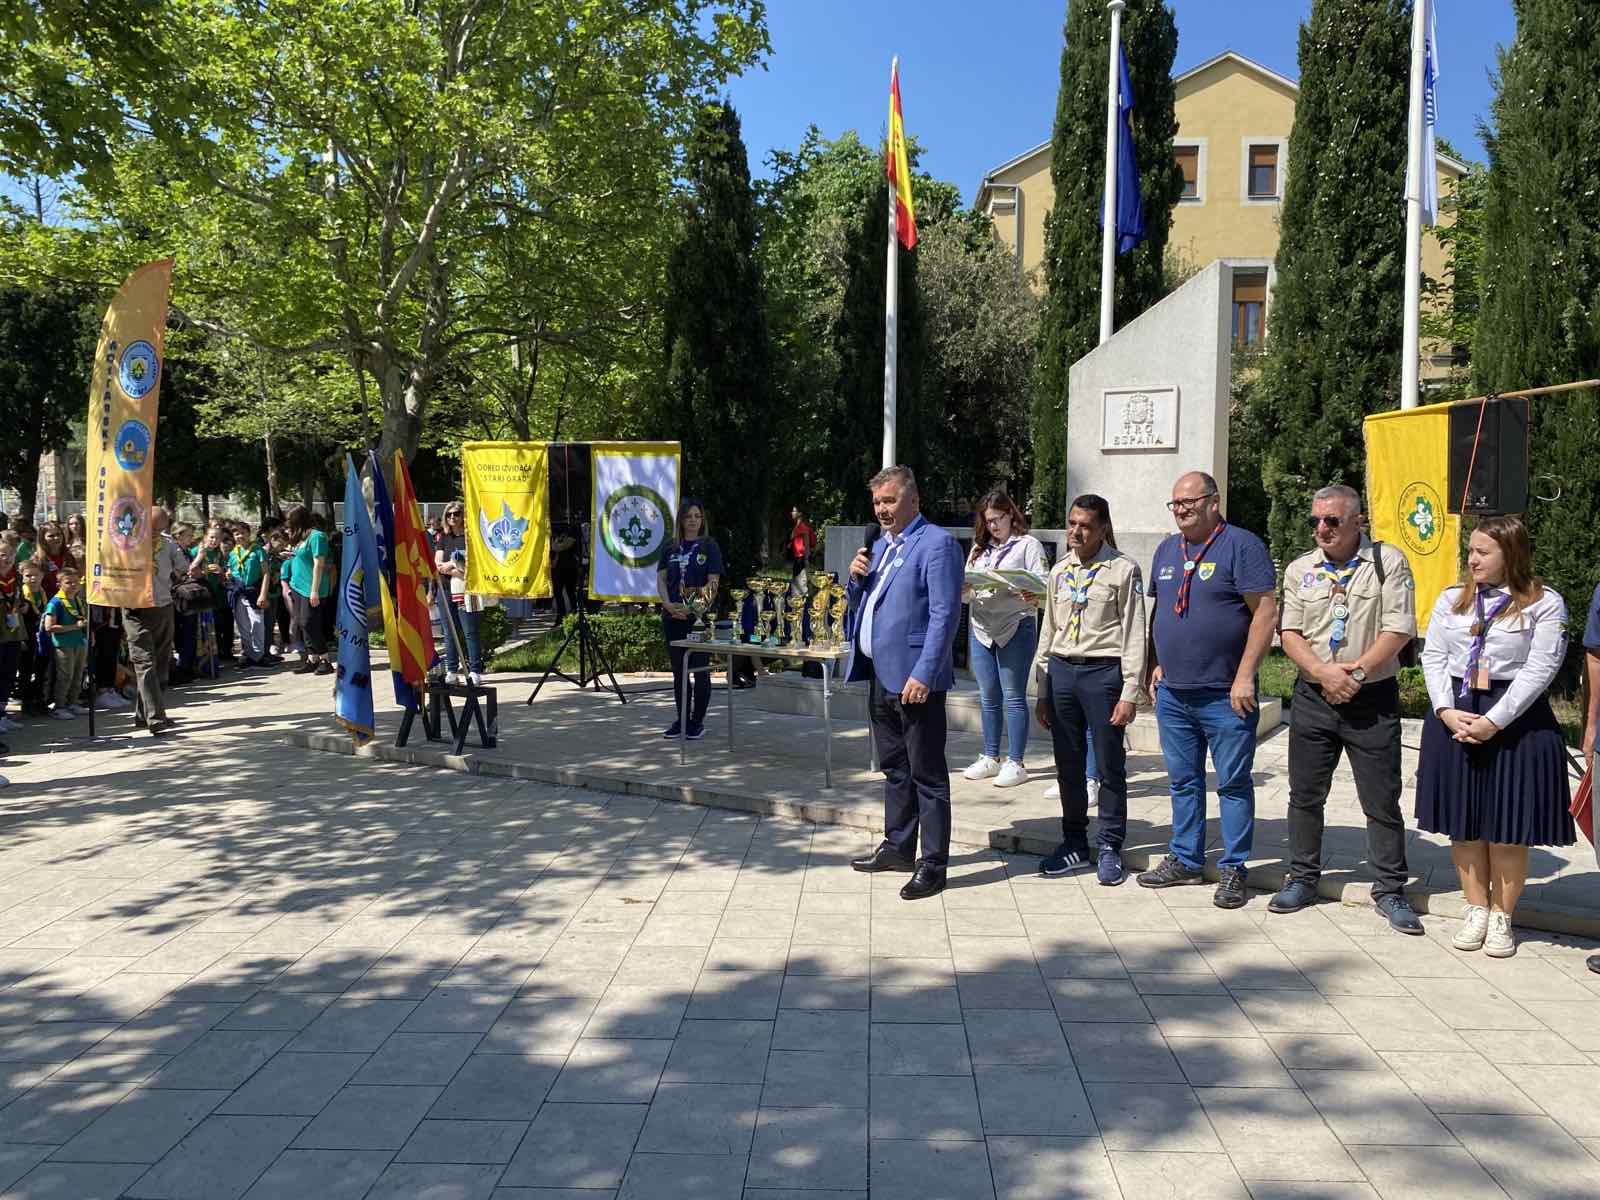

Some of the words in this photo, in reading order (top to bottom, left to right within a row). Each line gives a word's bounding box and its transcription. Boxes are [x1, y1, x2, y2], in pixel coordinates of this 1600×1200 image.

[1113, 433, 1164, 446] ESPAÑA
[97, 466, 106, 552] SUSRETI
[484, 575, 529, 584] MOSTAR
